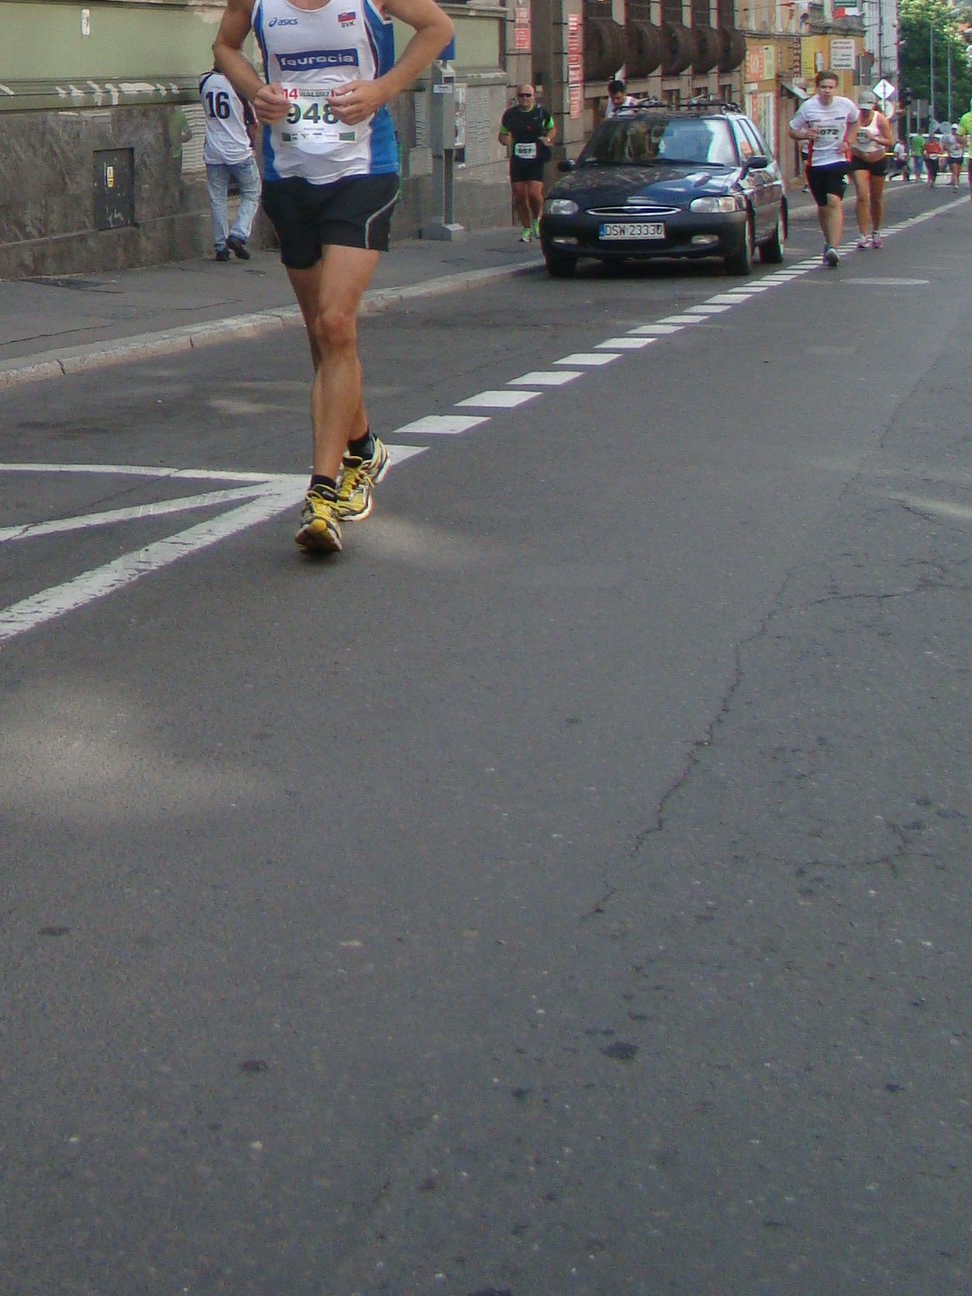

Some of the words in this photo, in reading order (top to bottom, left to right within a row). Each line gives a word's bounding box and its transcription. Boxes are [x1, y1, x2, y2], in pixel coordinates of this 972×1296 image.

[277, 18, 298, 26] asics
[280, 53, 354, 66] faurecia
[283, 88, 299, 100] 14
[206, 91, 231, 120] 16
[286, 103, 339, 125] 948
[605, 224, 626, 236] DSW
